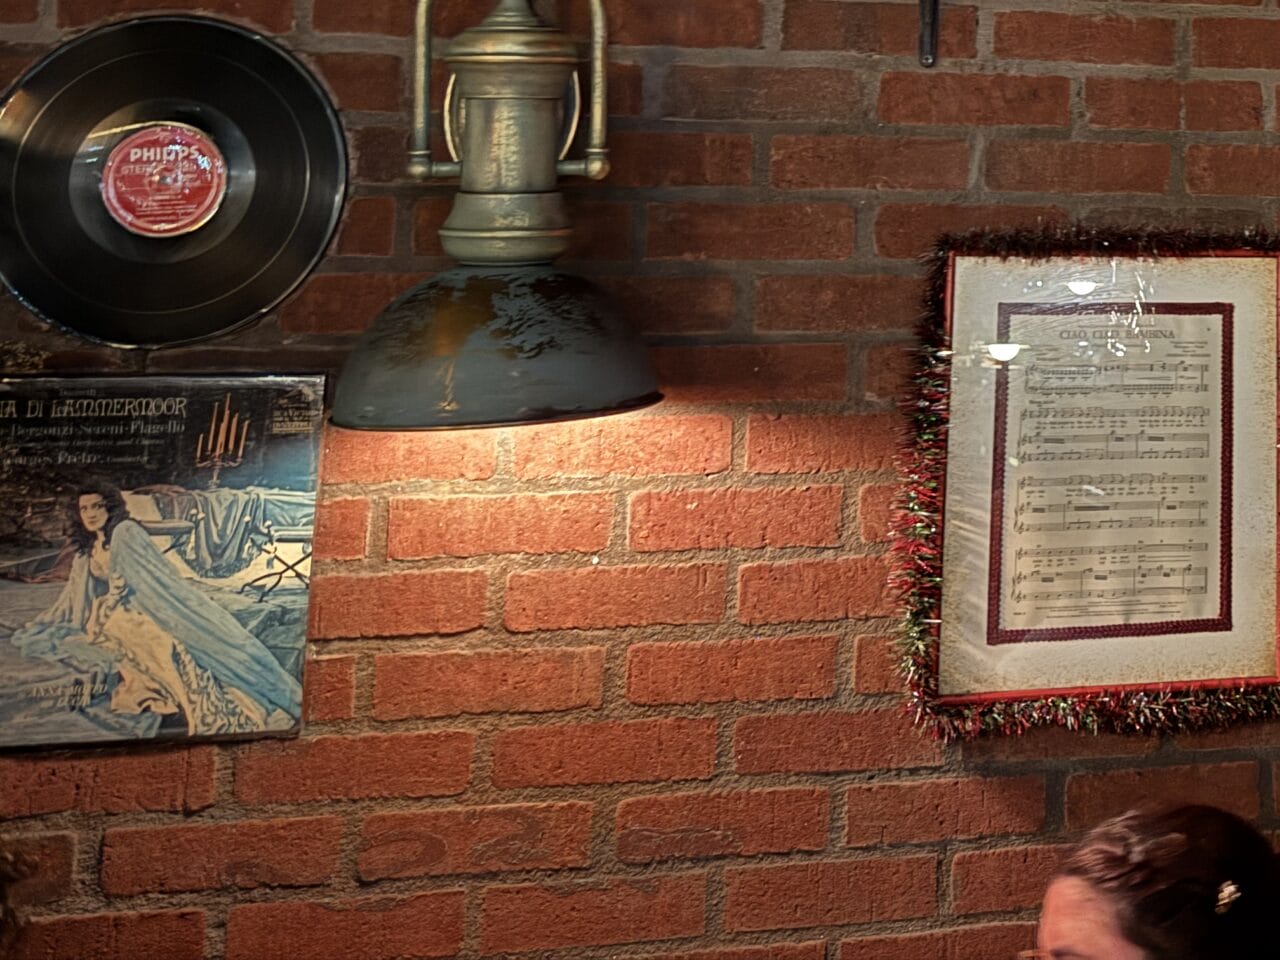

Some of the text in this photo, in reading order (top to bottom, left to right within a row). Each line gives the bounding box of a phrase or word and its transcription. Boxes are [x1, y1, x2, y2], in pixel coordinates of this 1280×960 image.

[130, 145, 200, 162] PHILIPS
[1060, 330, 1086, 340] CIAO
[26, 400, 43, 418] DI
[51, 397, 187, 418] LAMMERMOOR
